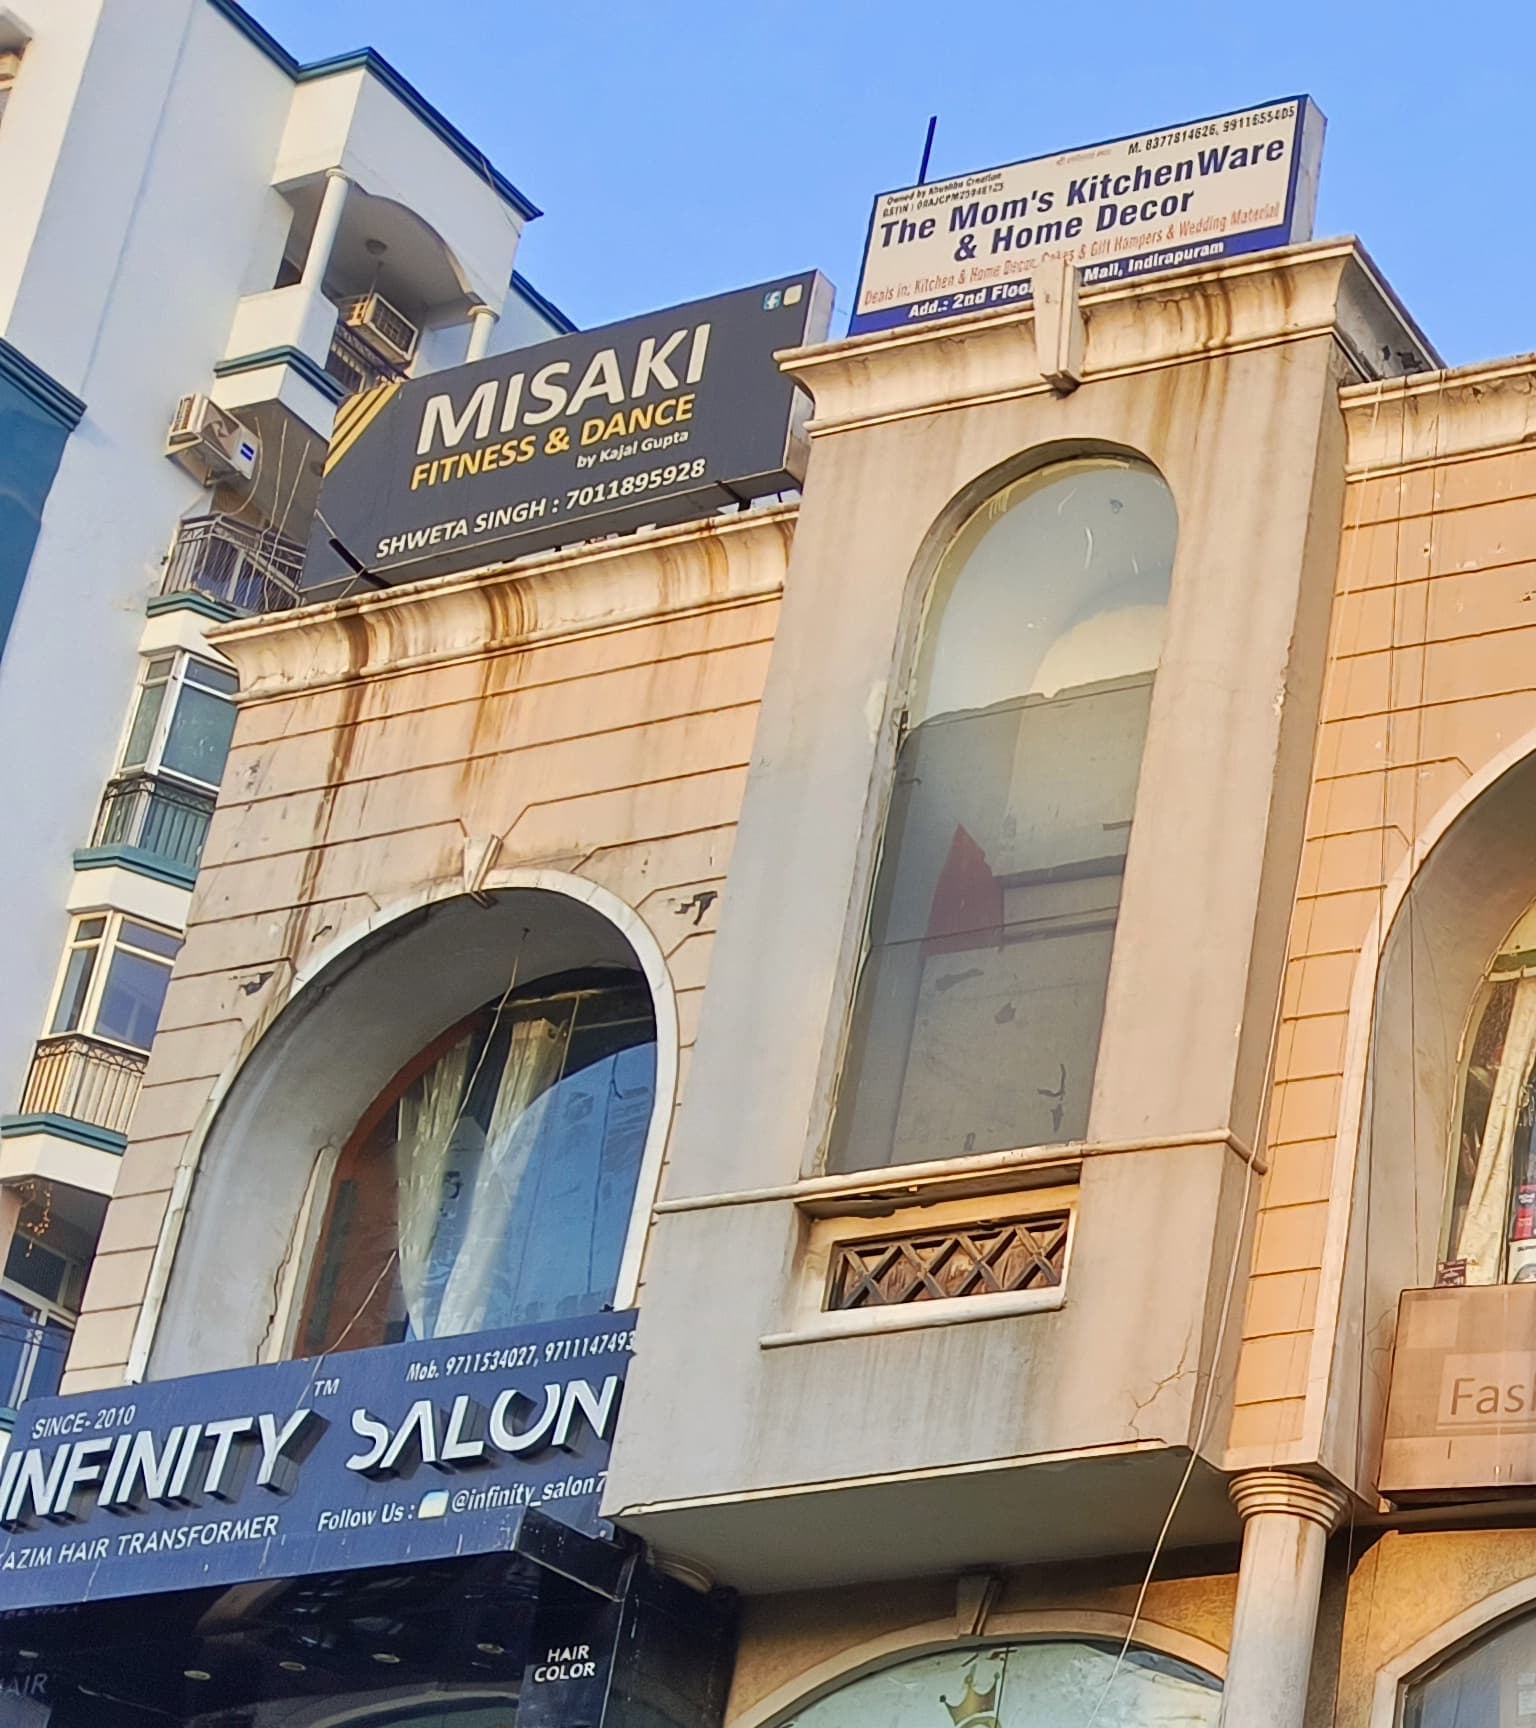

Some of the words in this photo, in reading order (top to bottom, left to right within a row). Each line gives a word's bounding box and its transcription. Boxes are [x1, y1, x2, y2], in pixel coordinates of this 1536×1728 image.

[881, 218, 936, 248] The
[948, 190, 1054, 233] Mom's
[1066, 137, 1285, 207] KitchenWare
[990, 214, 1083, 255] Home
[1095, 188, 1195, 232] Decor
[908, 298, 948, 320] Add.:
[952, 289, 986, 311] 2nd
[1128, 240, 1225, 276] Indirapuram
[416, 324, 711, 455] MISAKI
[410, 435, 535, 491] FITNESS
[580, 394, 695, 445] DANCE
[577, 452, 596, 469] by
[599, 440, 638, 466] Kajal
[641, 430, 689, 455] Gupta
[376, 519, 468, 559] SHWETA
[473, 497, 547, 533] SINGH
[566, 458, 706, 510] 7011895928
[94, 1404, 136, 1429] 2010
[346, 1376, 618, 1473] SALON
[57, 1537, 110, 1565] HAIR
[117, 1514, 279, 1556] TRANSFORMER
[317, 1507, 377, 1532] Follow
[534, 1661, 596, 1683] COLOR
